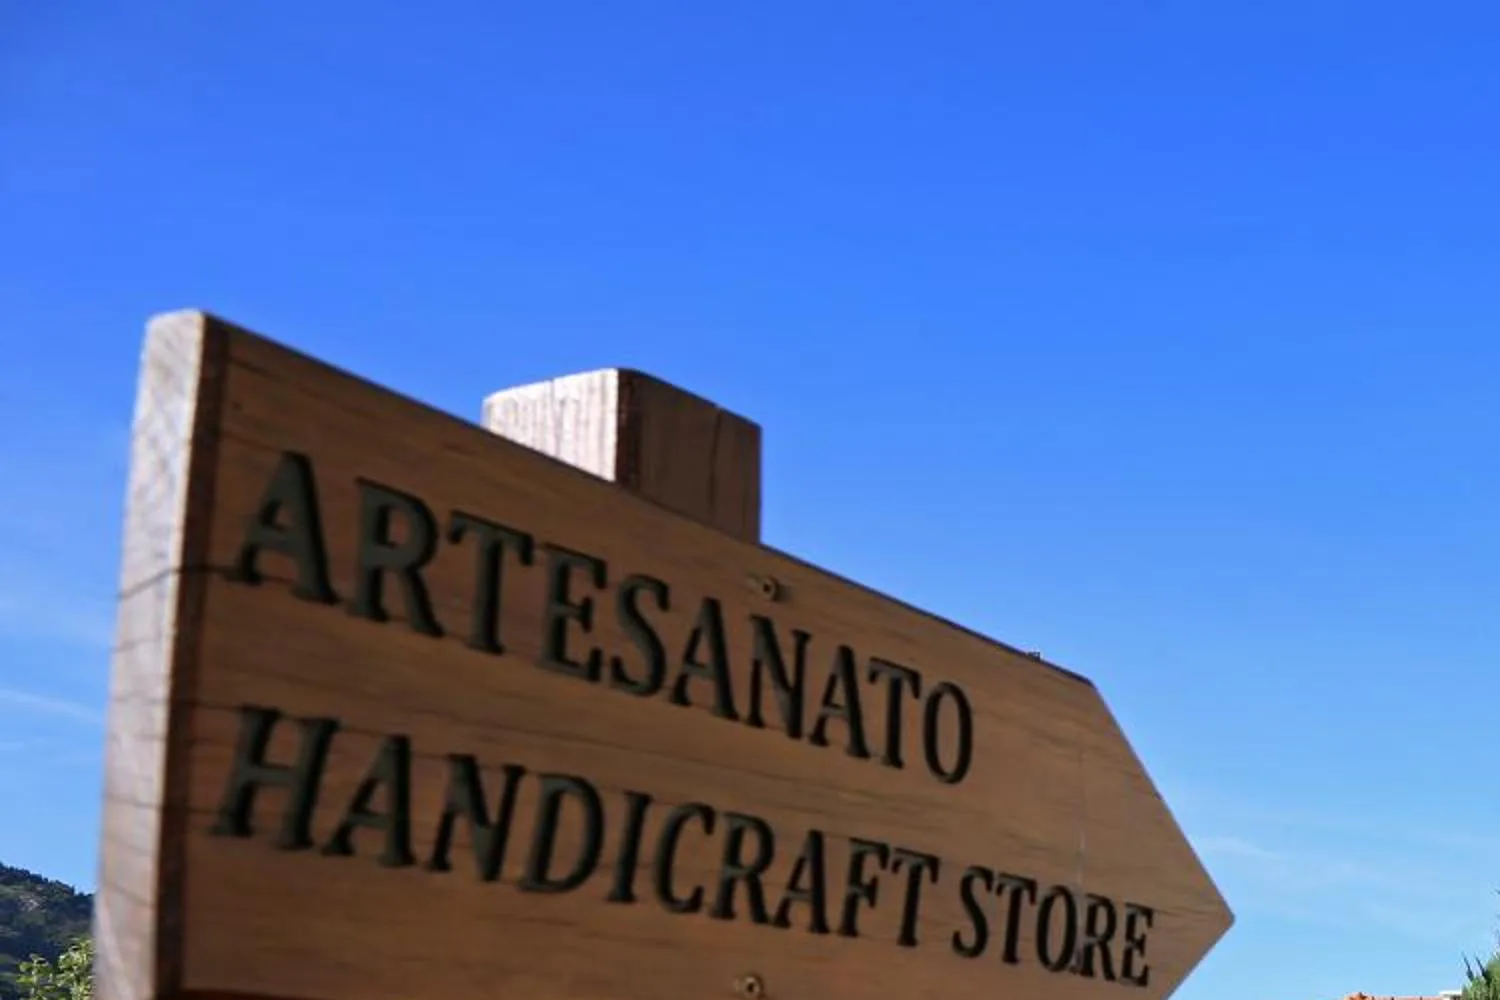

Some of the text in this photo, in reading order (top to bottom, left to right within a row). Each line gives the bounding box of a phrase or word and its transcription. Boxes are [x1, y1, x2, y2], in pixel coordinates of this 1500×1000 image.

[234, 449, 974, 785] ARTESANATO
[212, 703, 1156, 989] HANDICRAFT STORE
